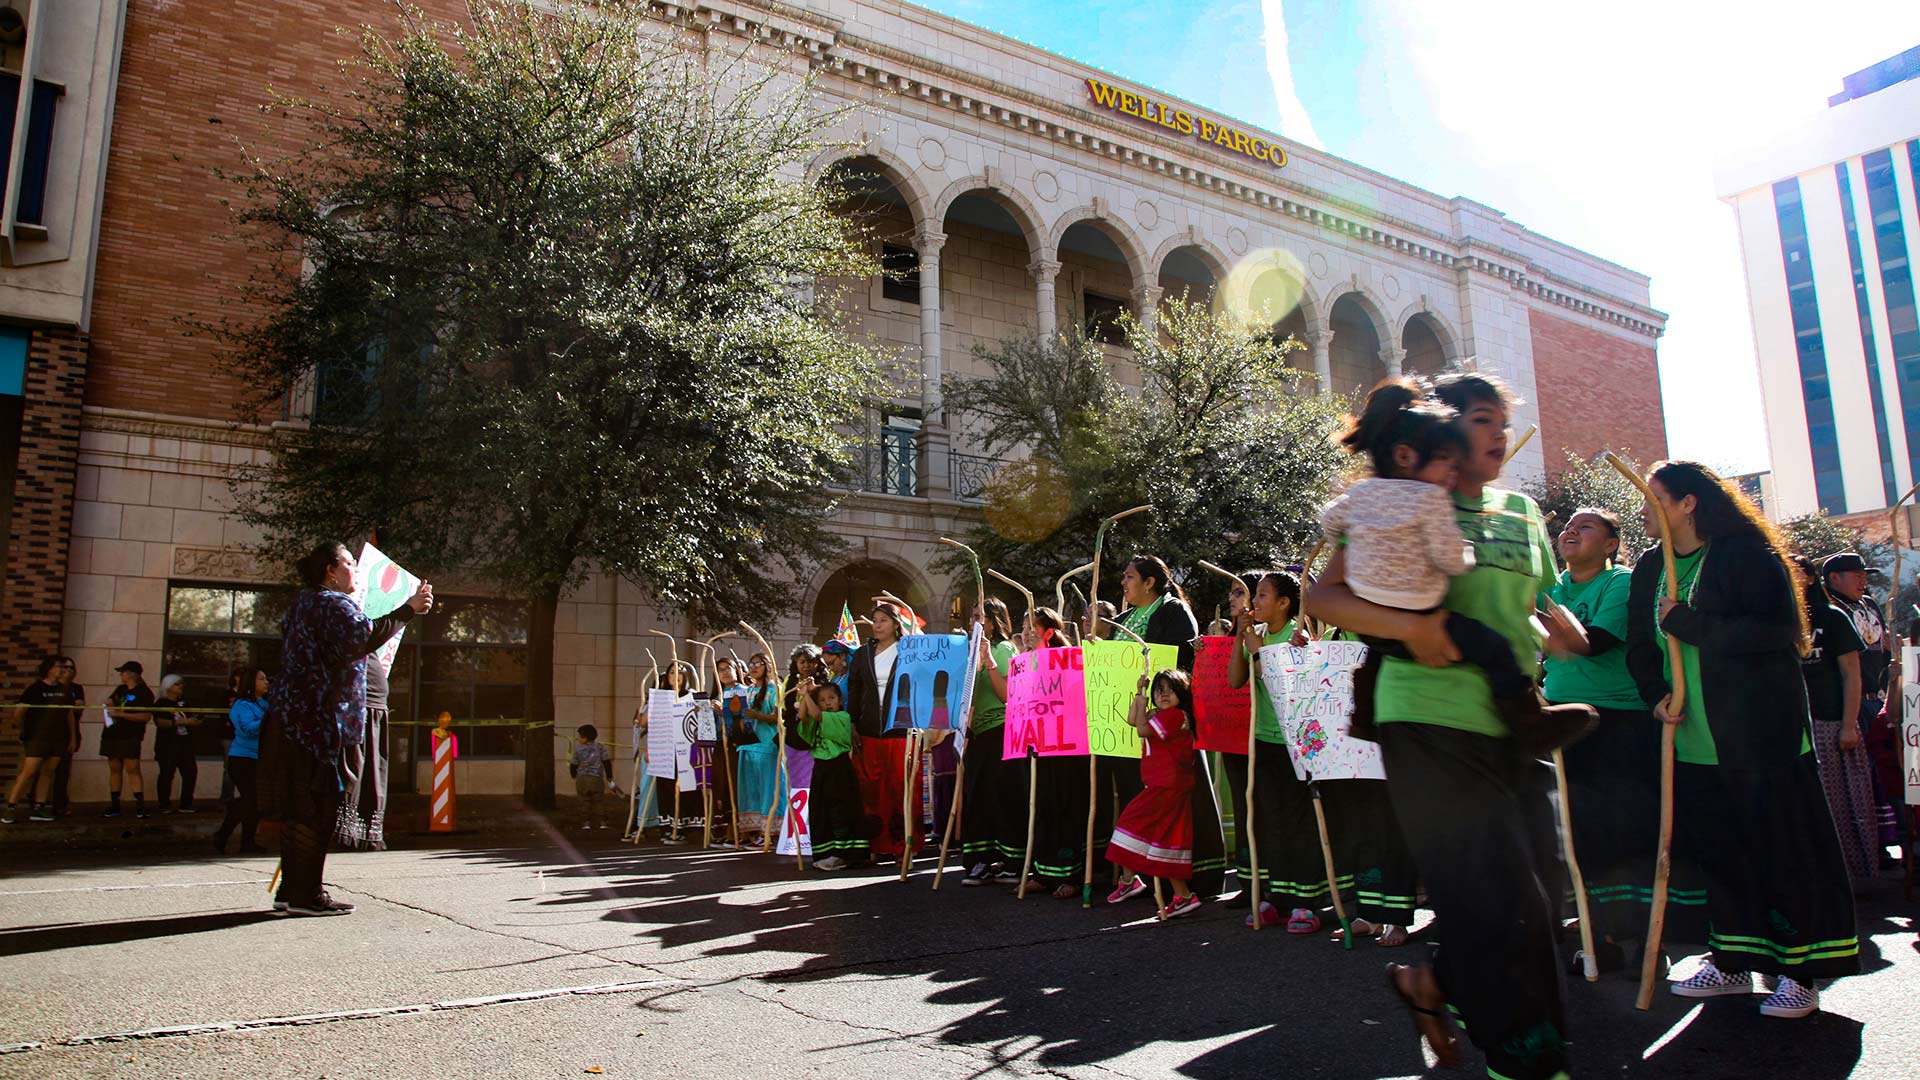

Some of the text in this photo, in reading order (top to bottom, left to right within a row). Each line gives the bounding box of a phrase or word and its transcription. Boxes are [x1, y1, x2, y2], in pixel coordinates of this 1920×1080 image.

[1085, 79, 1288, 168] WELLS FARGO
[1089, 671, 1109, 688] AN
[1009, 715, 1077, 755] WALL
